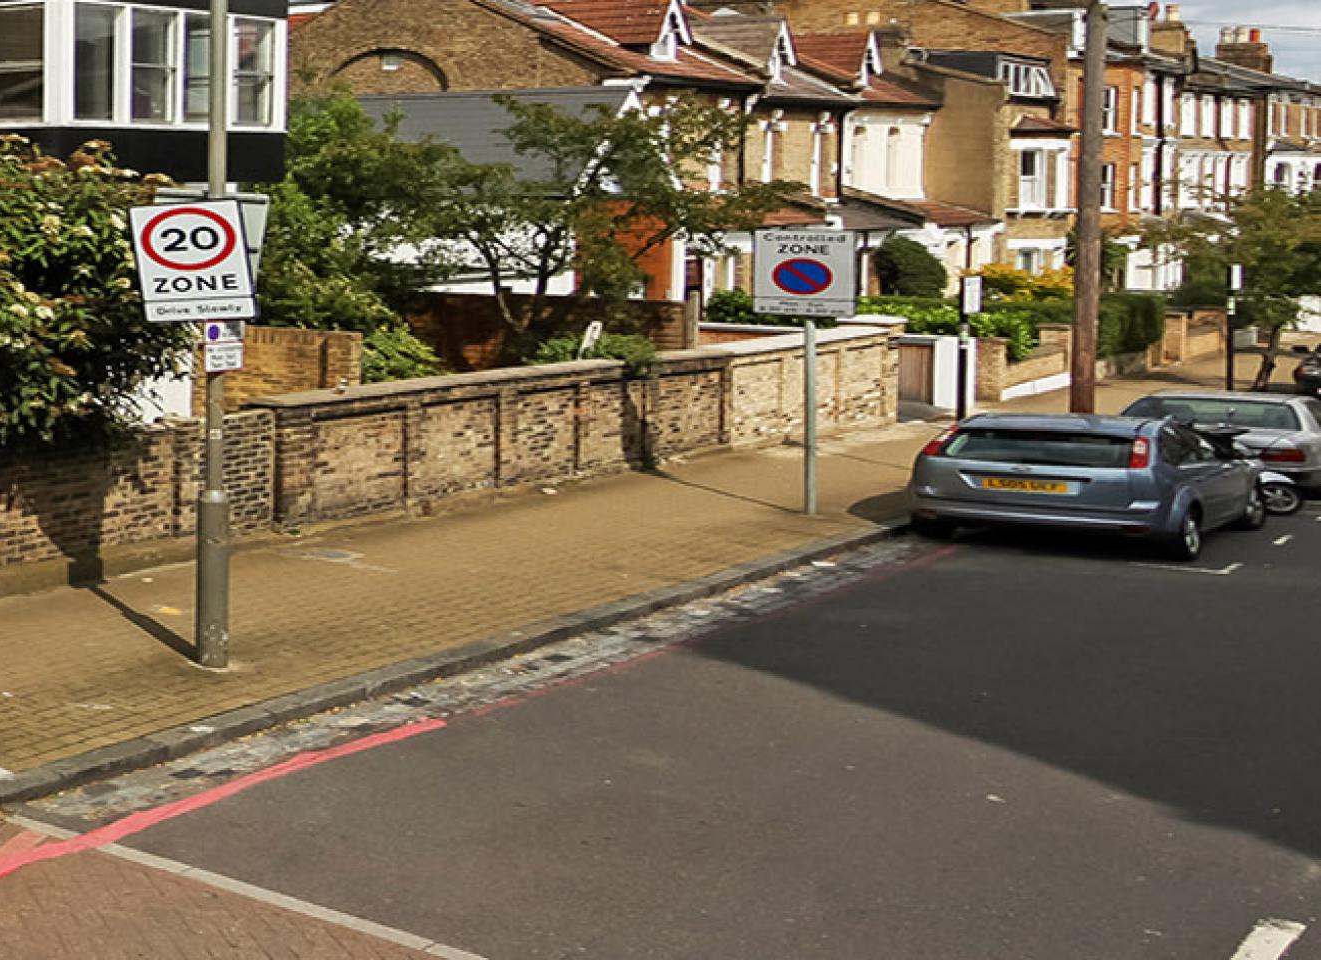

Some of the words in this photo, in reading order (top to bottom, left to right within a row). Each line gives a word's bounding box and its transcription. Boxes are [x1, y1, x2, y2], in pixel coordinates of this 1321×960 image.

[160, 226, 220, 252] 20
[763, 233, 846, 243] Controlled
[778, 244, 830, 255] ZONE
[153, 273, 239, 293] ZONE
[156, 306, 191, 315] Drive
[197, 303, 243, 314] Slowly
